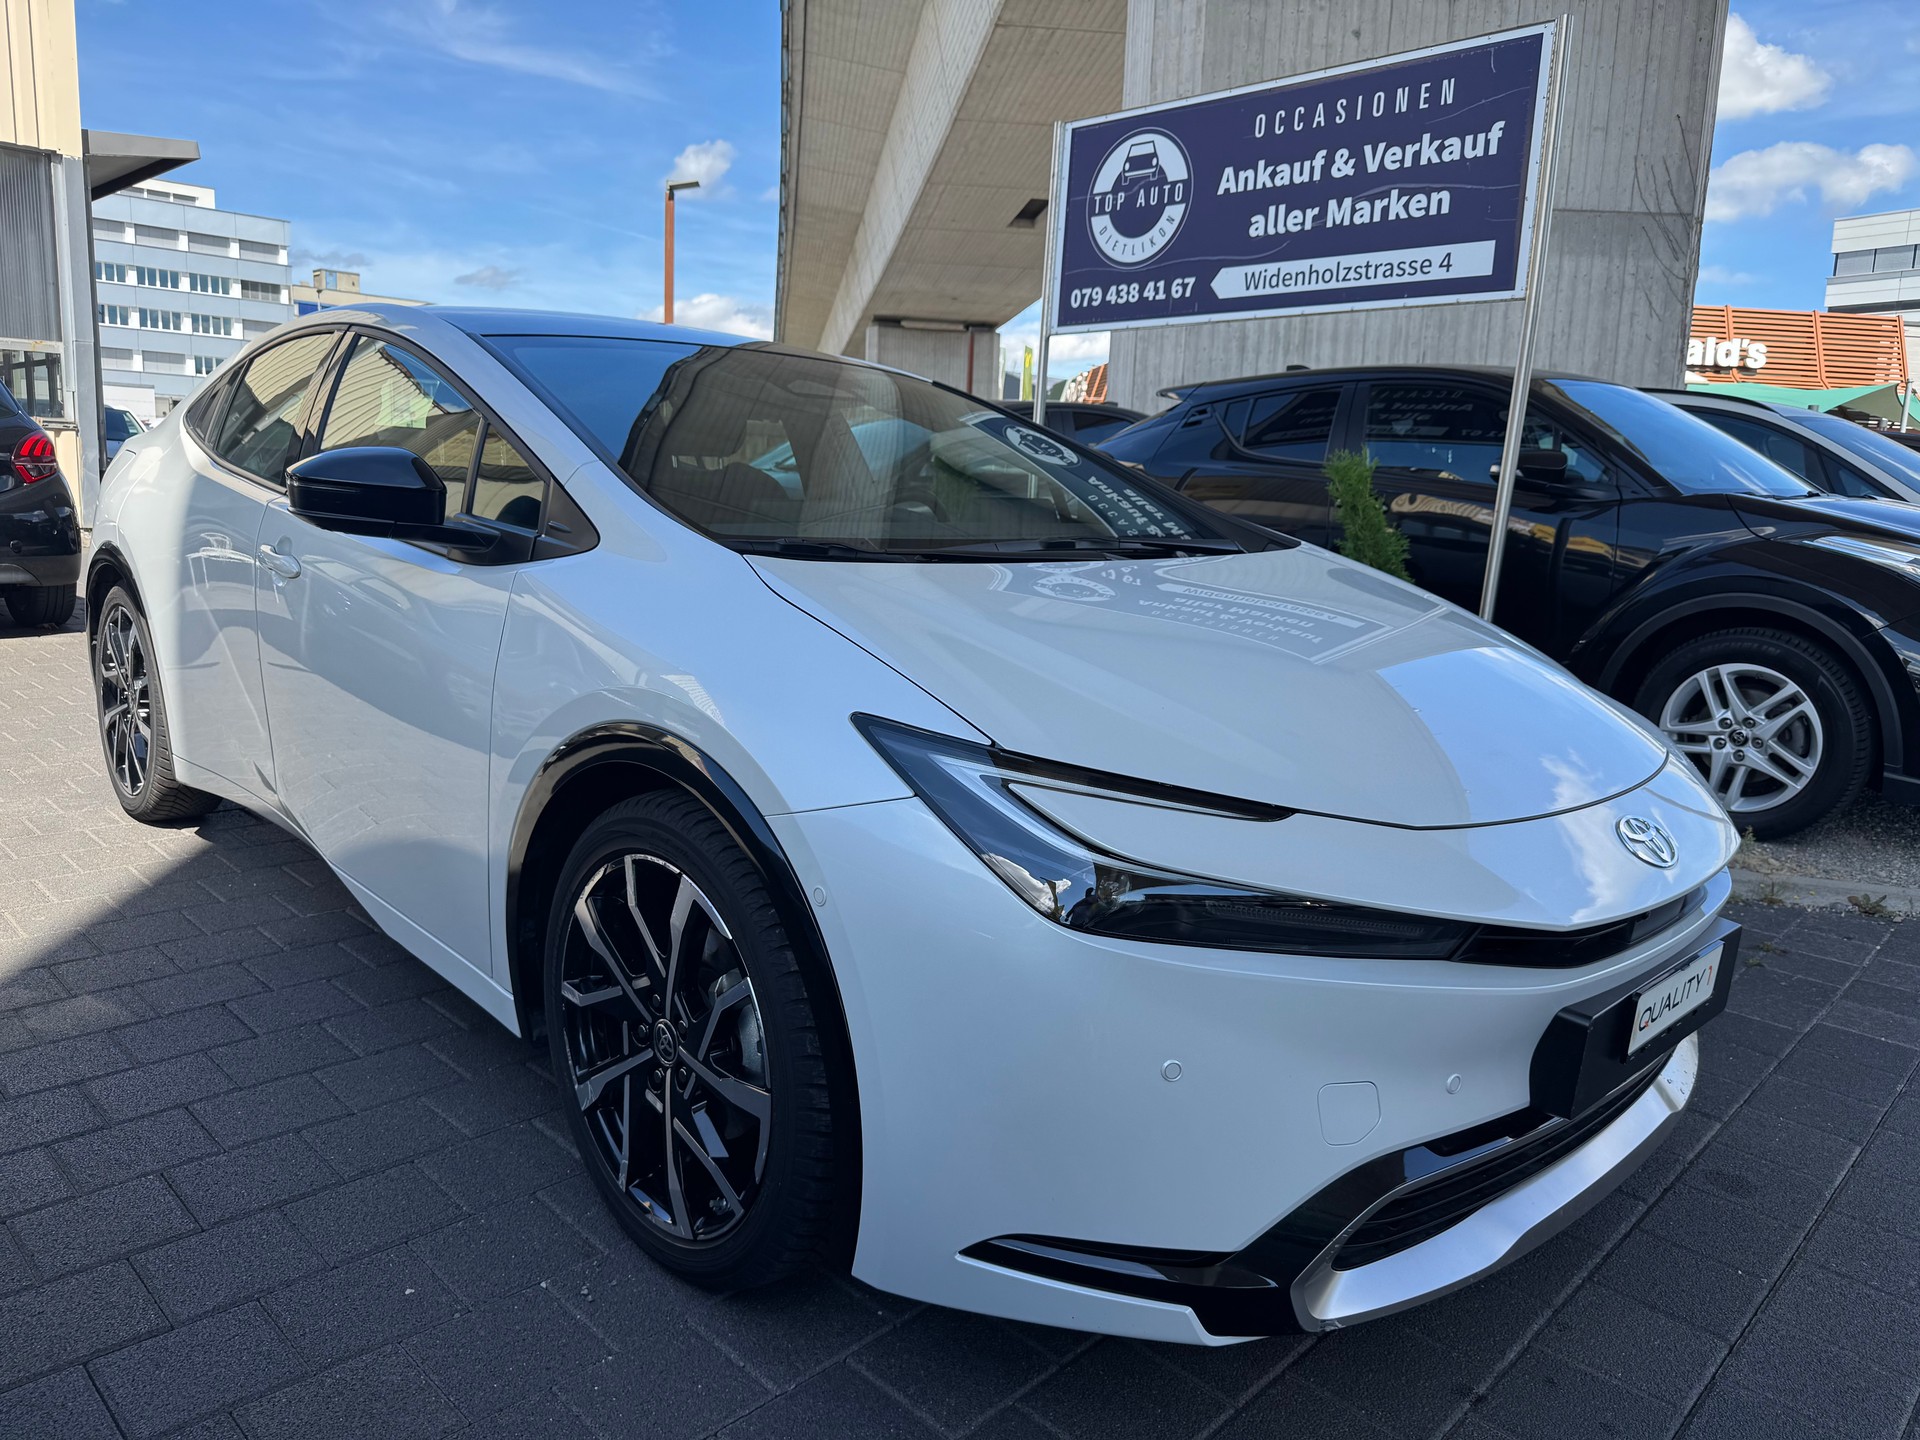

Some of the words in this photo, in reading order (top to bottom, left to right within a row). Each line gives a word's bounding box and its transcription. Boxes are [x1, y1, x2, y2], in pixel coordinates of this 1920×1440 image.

[1254, 78, 1455, 138] OCCASIONEN
[1217, 150, 1328, 195] Ankauf
[1331, 148, 1356, 178] &
[1363, 121, 1506, 173] Verkauf
[1095, 192, 1125, 214] TOP
[1136, 183, 1183, 208] AUTO
[1249, 203, 1319, 237] aller
[1325, 189, 1450, 228] Marken
[1099, 215, 1175, 256] DIETLIKON
[1244, 258, 1432, 291] Widenholzstrasse
[1438, 252, 1453, 273] 4
[1070, 287, 1103, 308] 079
[1106, 283, 1139, 304] 438
[1143, 280, 1166, 301] 41
[1171, 277, 1196, 299] 67
